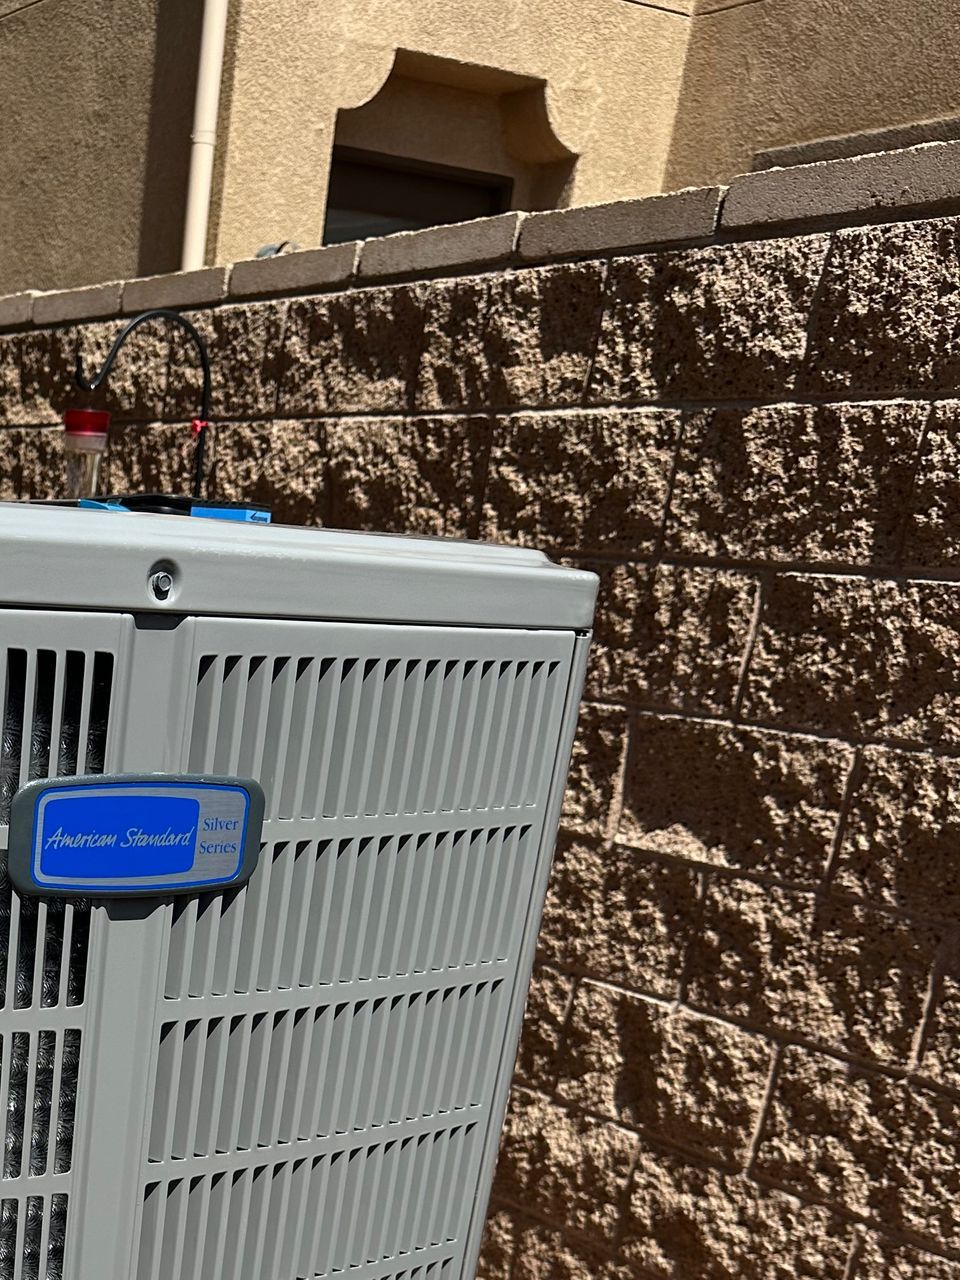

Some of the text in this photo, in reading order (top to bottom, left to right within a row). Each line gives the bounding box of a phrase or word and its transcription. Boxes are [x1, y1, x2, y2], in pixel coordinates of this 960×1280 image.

[203, 817, 239, 831] Silver
[45, 826, 196, 850] American Standard
[199, 841, 237, 854] Series
